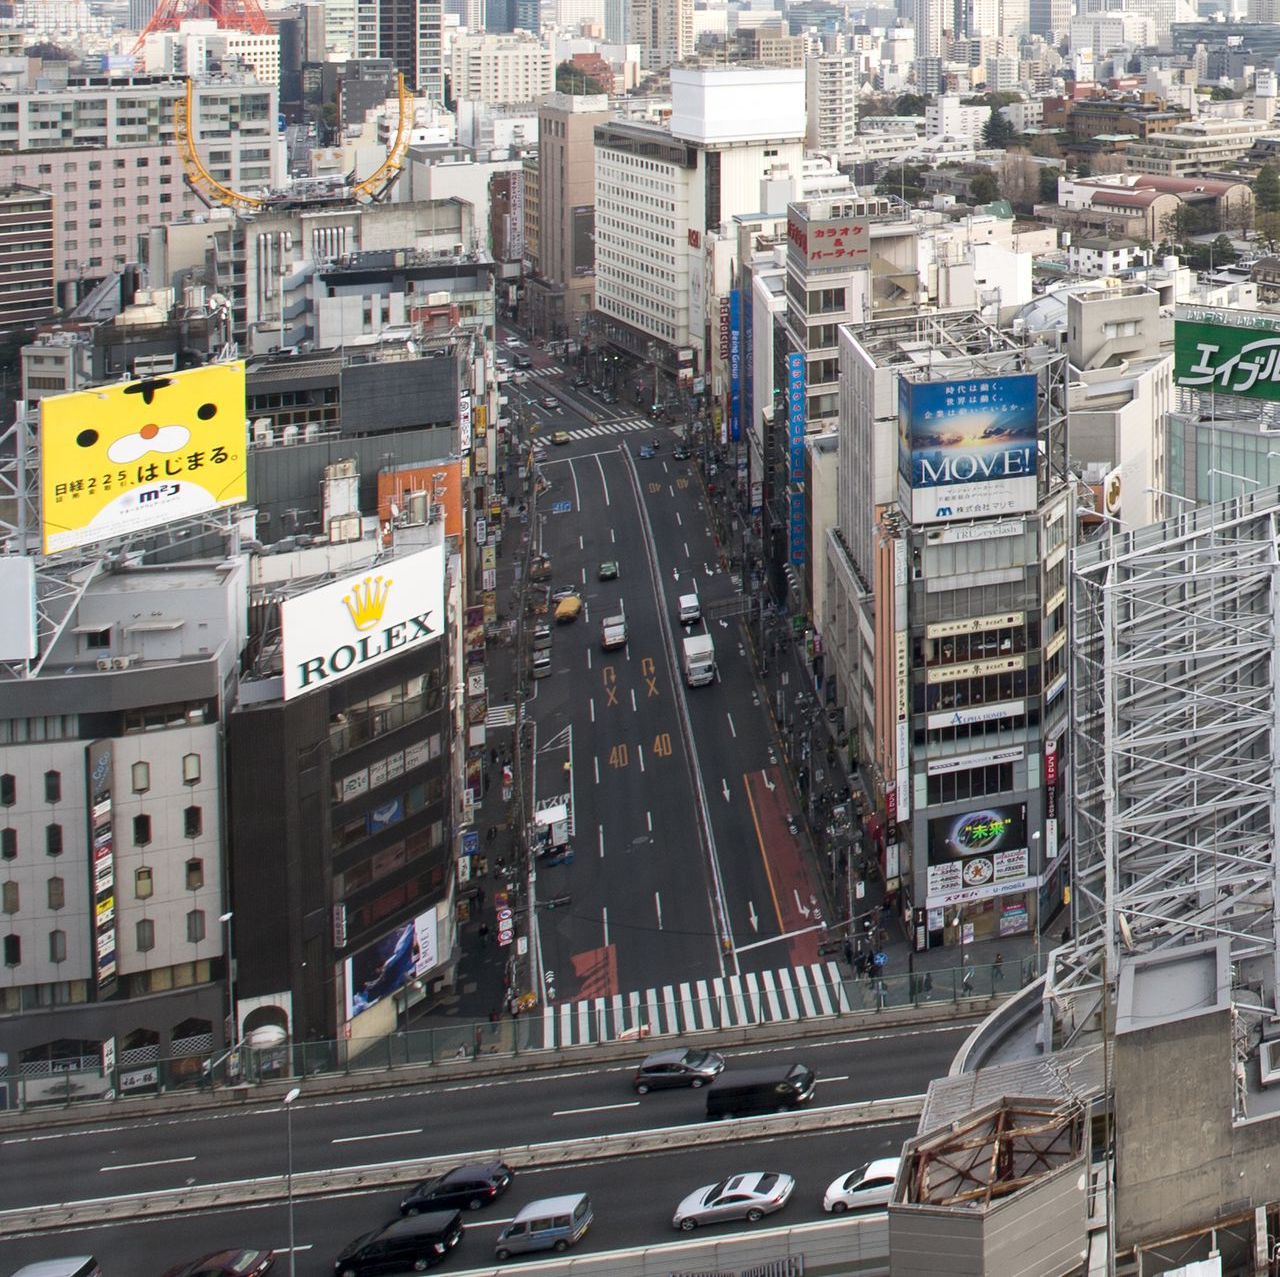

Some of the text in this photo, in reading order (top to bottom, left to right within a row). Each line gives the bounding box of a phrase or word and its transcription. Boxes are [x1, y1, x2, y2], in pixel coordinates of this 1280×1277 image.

[814, 225, 863, 239] カラオケ
[919, 447, 1031, 484] MOVE!
[297, 609, 436, 690] ROLEX
[607, 743, 629, 769] 40
[652, 732, 673, 757] 40
